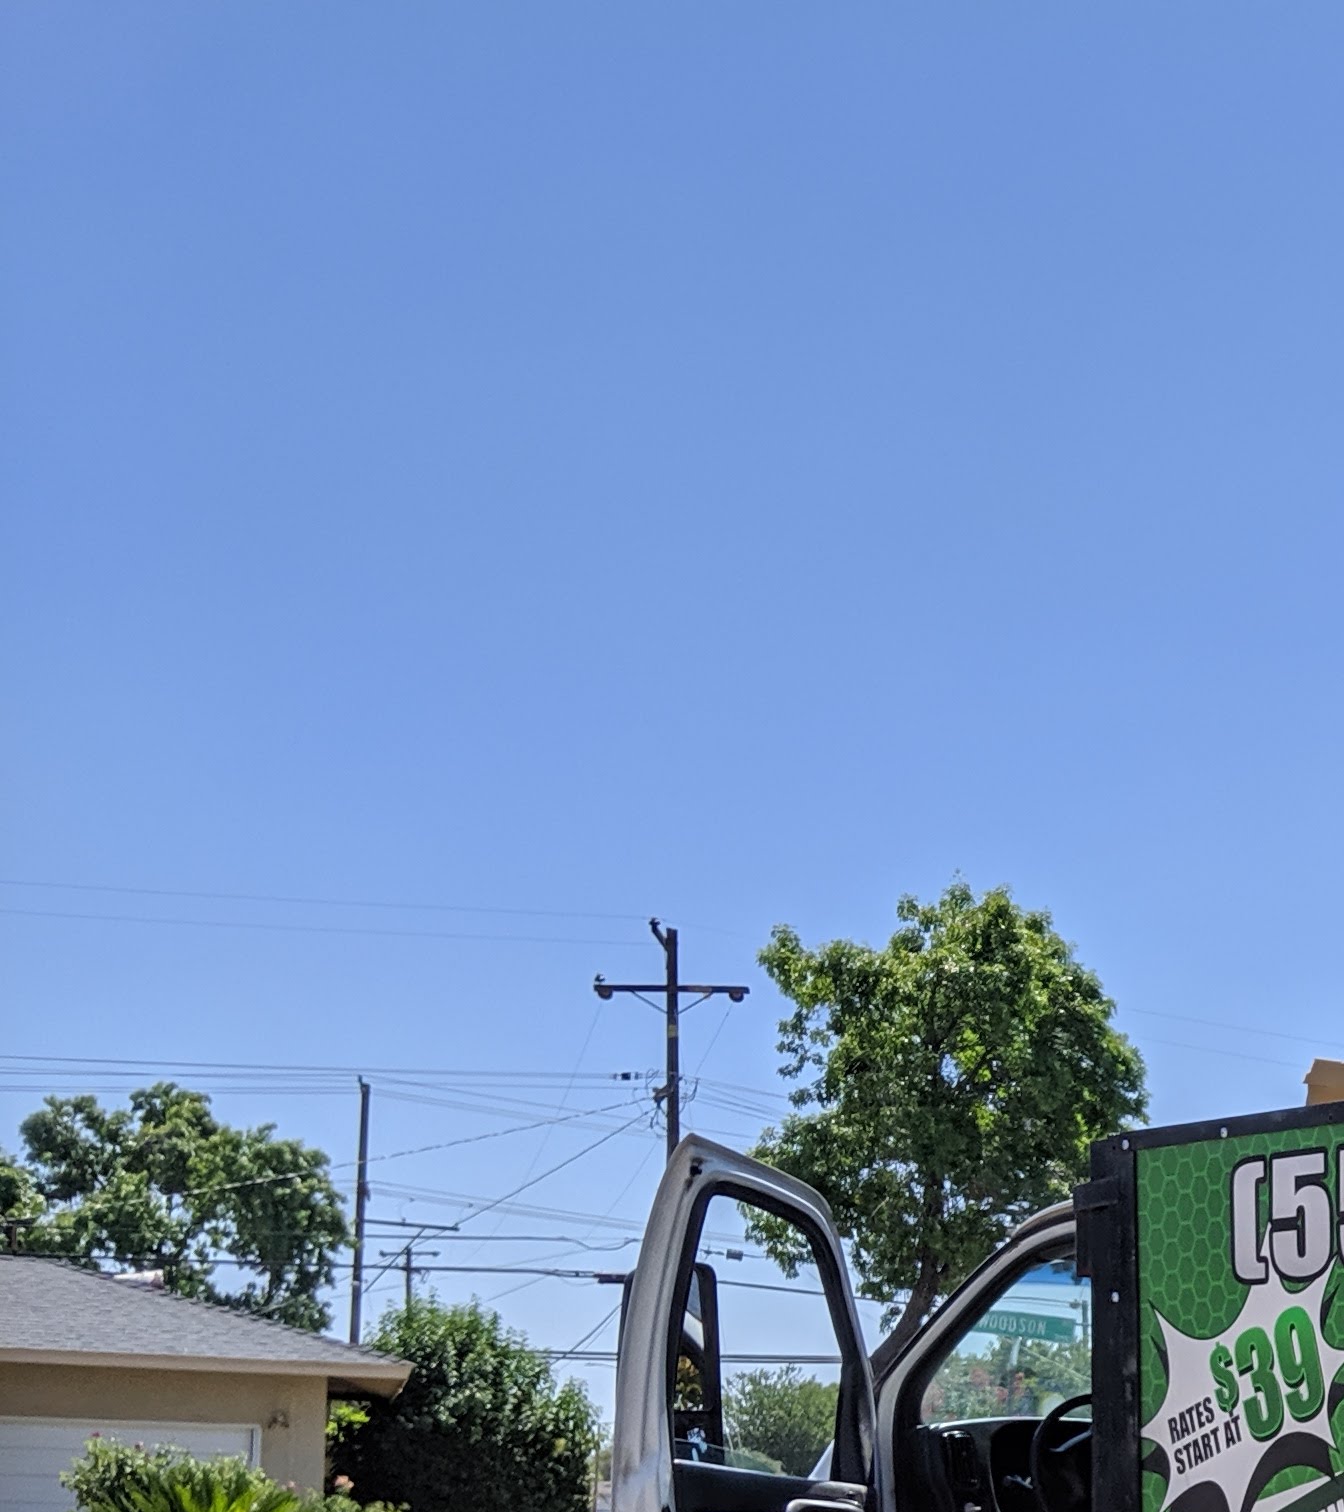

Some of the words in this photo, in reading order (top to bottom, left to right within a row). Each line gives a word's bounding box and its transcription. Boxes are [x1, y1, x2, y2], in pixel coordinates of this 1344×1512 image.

[1210, 1306, 1326, 1443] $39
[1168, 1397, 1215, 1444] RATES
[1174, 1427, 1222, 1475] START
[1224, 1415, 1243, 1449] AT
